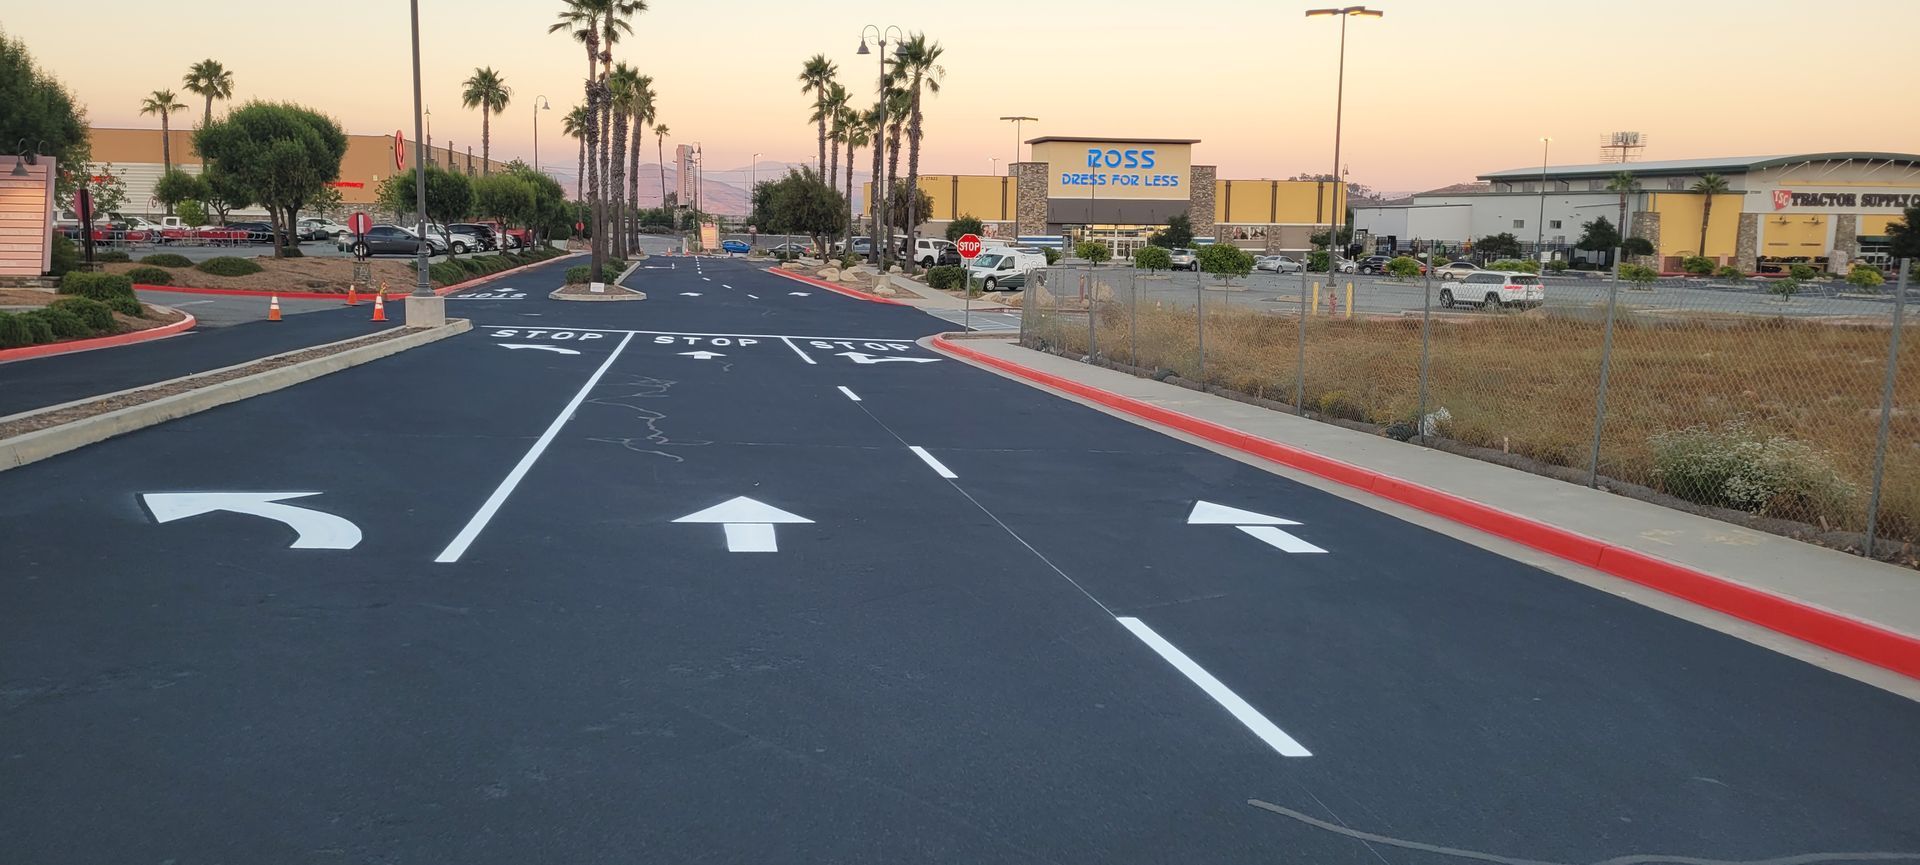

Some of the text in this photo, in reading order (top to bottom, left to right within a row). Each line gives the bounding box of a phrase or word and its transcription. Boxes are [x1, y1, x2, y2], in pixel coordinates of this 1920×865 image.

[1087, 149, 1156, 169] ROSS
[1061, 173, 1179, 187] DRESS FOR LESS
[1773, 190, 1789, 206] TSC
[1791, 193, 1857, 207] TRACTOR
[1861, 193, 1911, 207] SUPPLY
[959, 241, 980, 251] STOP
[490, 329, 604, 341] STOP
[653, 336, 758, 347] STOP
[809, 340, 910, 351] STOP
